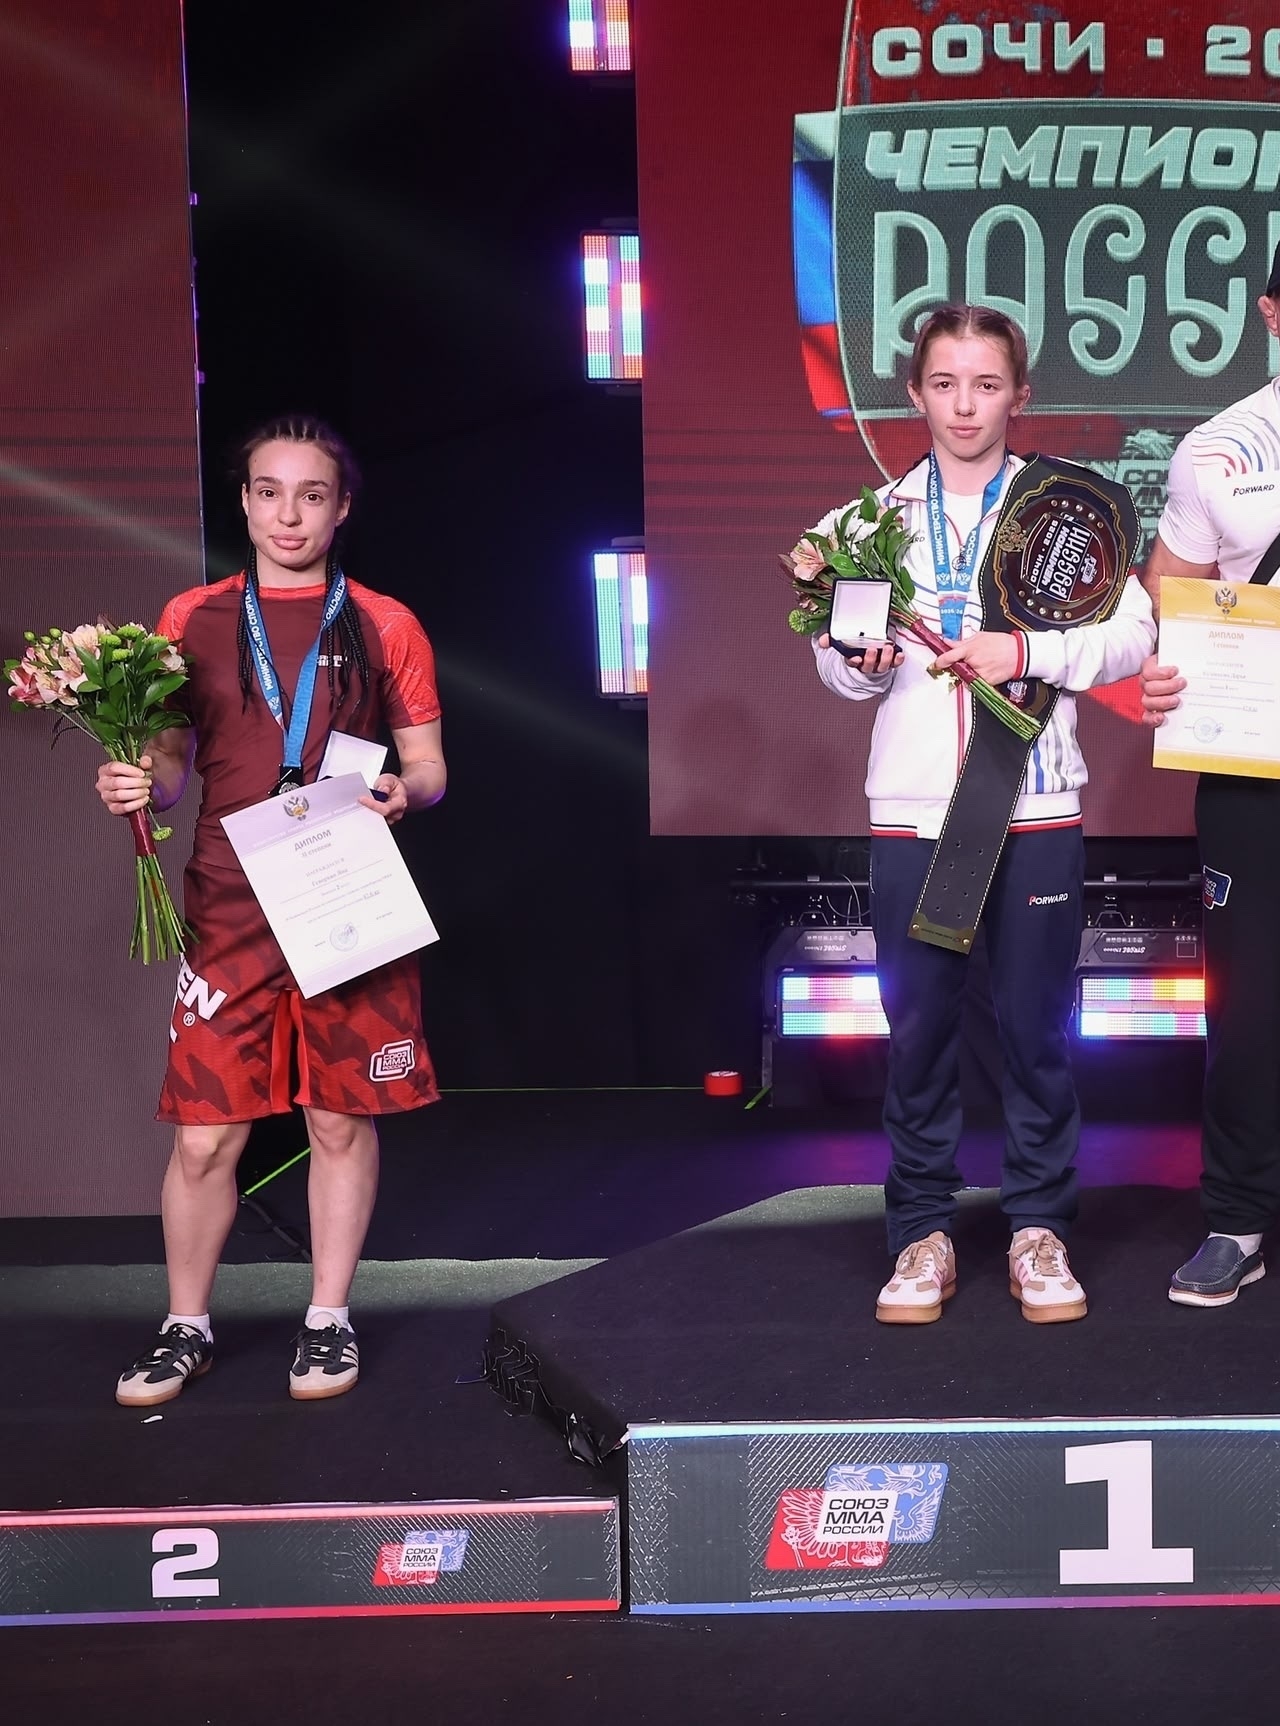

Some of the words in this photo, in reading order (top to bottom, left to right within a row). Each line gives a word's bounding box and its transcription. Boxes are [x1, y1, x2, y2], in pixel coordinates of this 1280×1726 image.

[871, 22, 1106, 78] СОЧИ
[1232, 483, 1275, 497] FORWARD
[930, 498, 946, 566] МИНИСТЕРСТВО
[966, 529, 977, 567] РОССИИ
[1041, 525, 1070, 586] ЧЕМПИОН
[1048, 526, 1091, 599] РОССИИ
[244, 594, 258, 626] СПОРТА
[1208, 630, 1245, 641] ДИПЛОМ
[293, 828, 332, 852] ДИПЛОМ
[1028, 892, 1069, 906] FORWARD
[382, 1057, 407, 1067] ММА
[829, 1498, 889, 1510] СОЮЗ
[1057, 1440, 1196, 1586] 1
[825, 1511, 885, 1525] ММА
[822, 1525, 884, 1535] РОССИИ
[404, 1554, 437, 1562] ММА
[406, 1547, 439, 1555] СОЮЗ
[150, 1527, 221, 1598] 2
